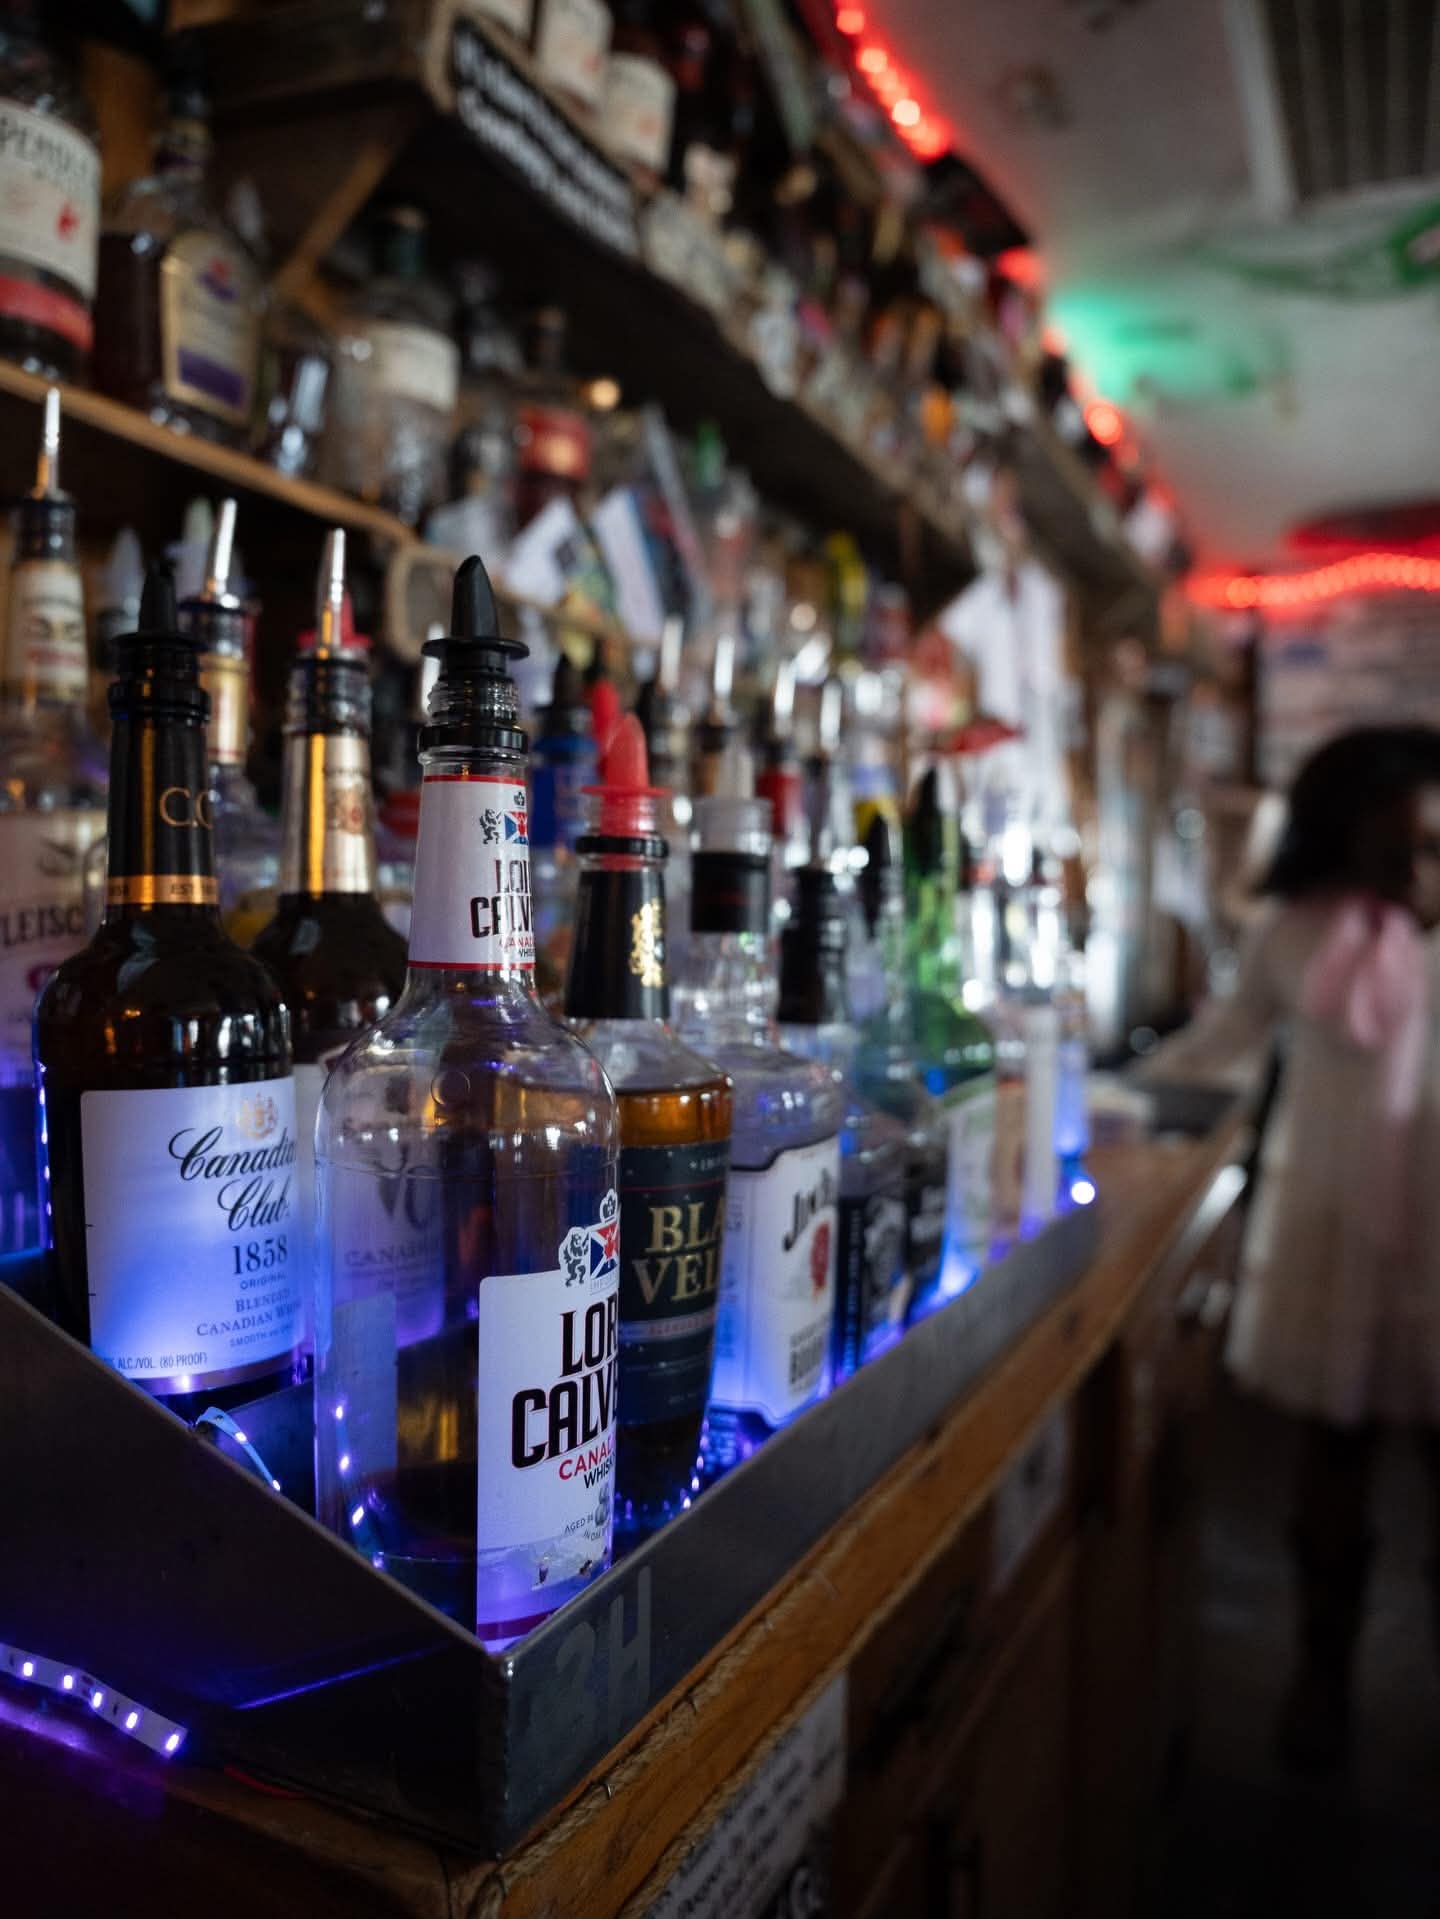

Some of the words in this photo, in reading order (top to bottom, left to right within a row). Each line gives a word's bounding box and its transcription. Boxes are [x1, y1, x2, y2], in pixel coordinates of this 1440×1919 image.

[470, 896, 533, 938] CALV
[217, 1175, 289, 1231] Club
[233, 1236, 287, 1275] 1858
[196, 1310, 273, 1337] CANADIAN
[511, 1367, 617, 1469] CALV
[565, 1518, 586, 1534] AGED
